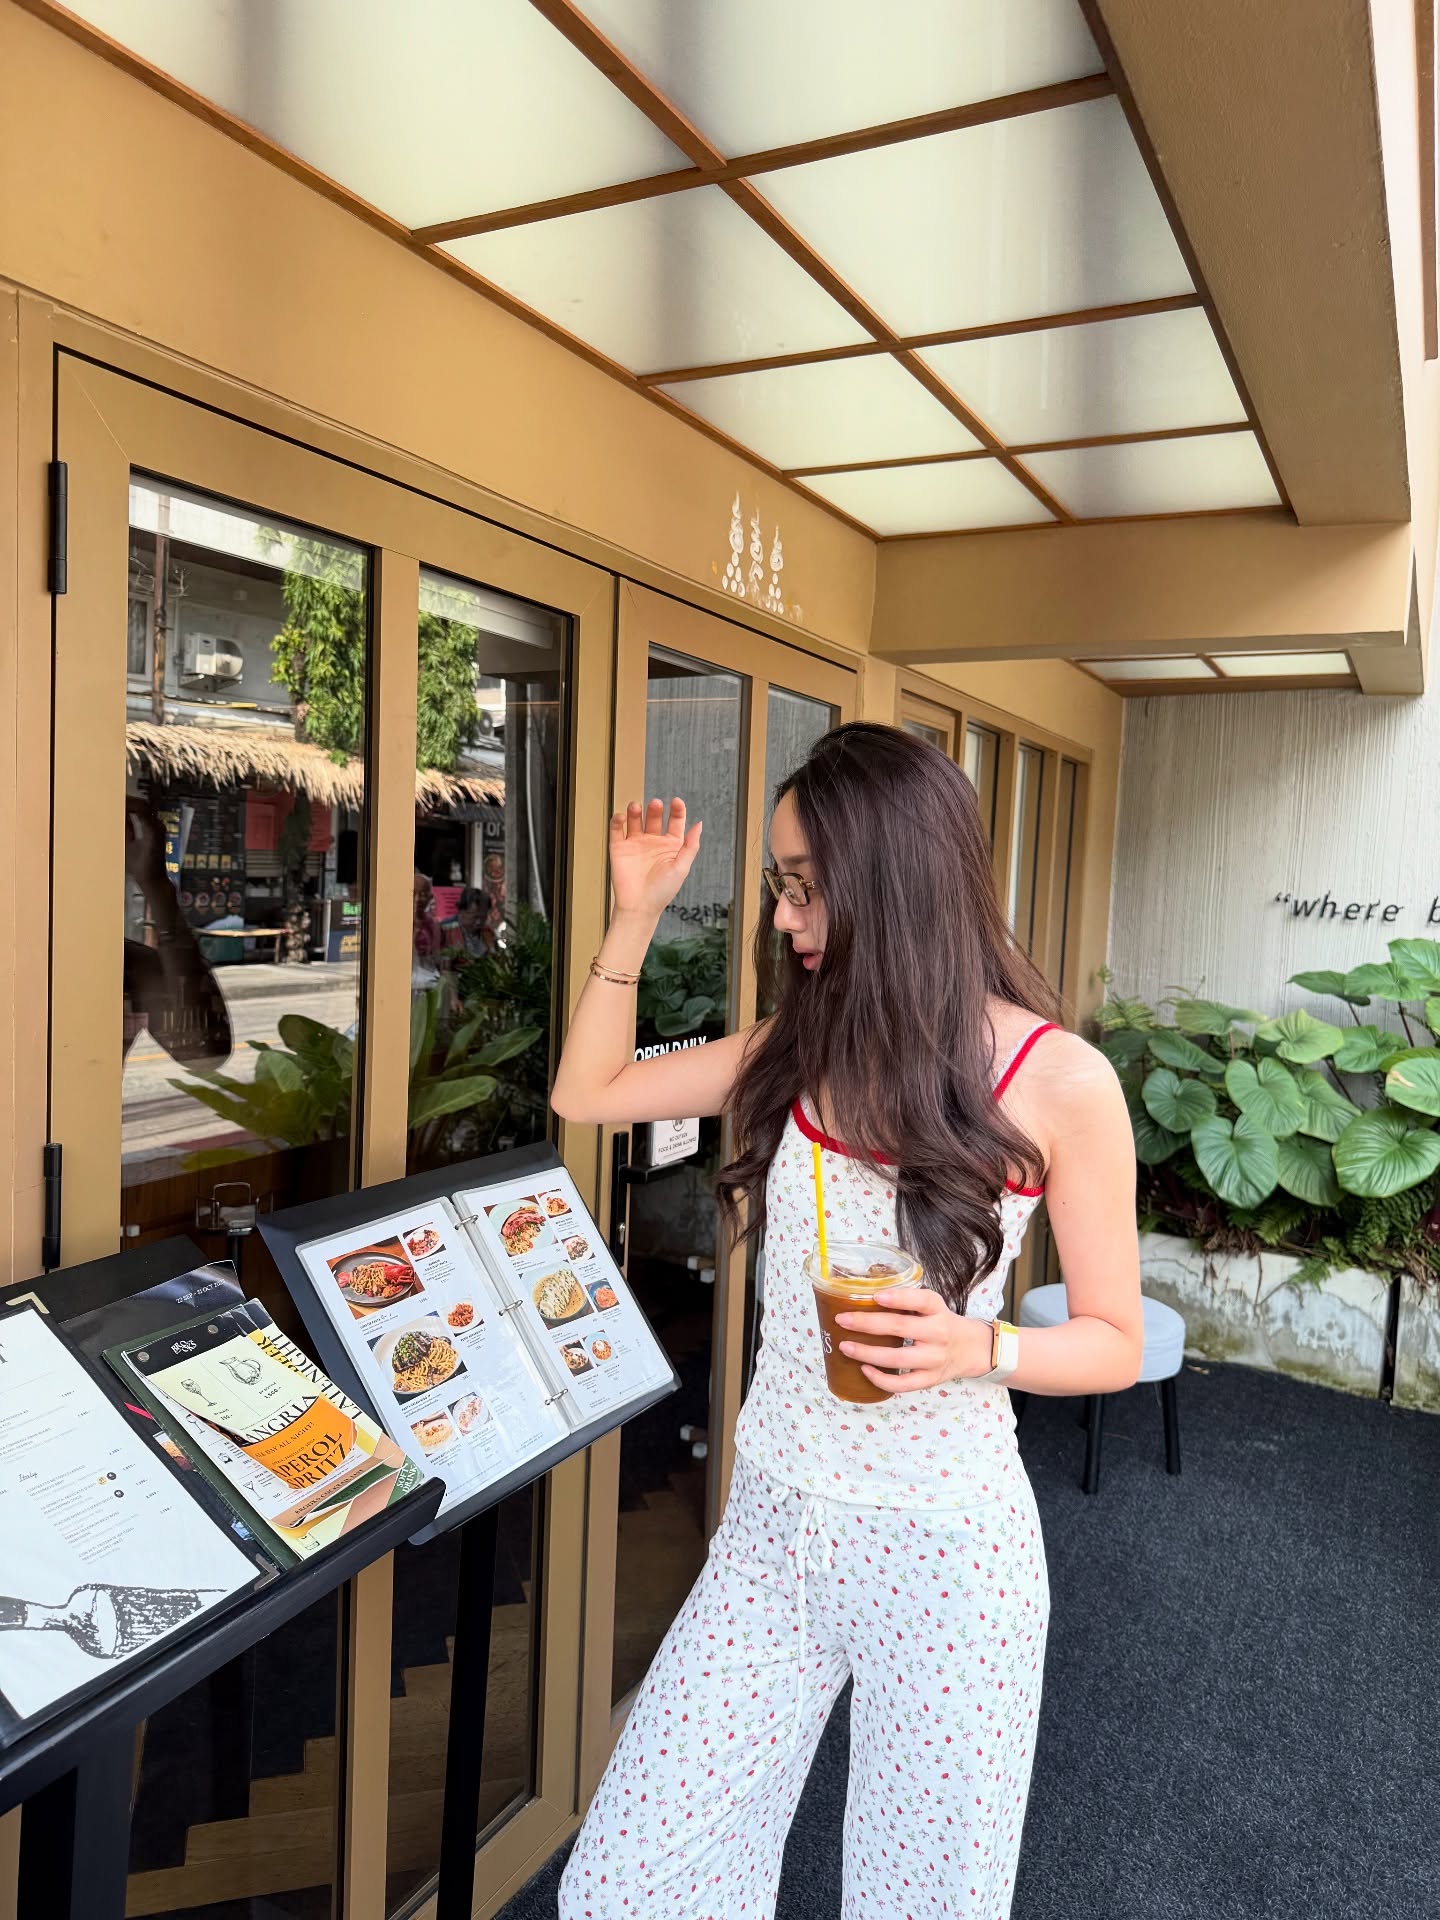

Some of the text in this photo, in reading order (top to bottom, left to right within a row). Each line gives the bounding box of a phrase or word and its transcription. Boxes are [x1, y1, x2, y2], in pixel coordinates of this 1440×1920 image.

[1274, 890, 1404, 922] “where
[634, 1043, 669, 1062] OPEN
[18, 1472, 38, 1482] Italy
